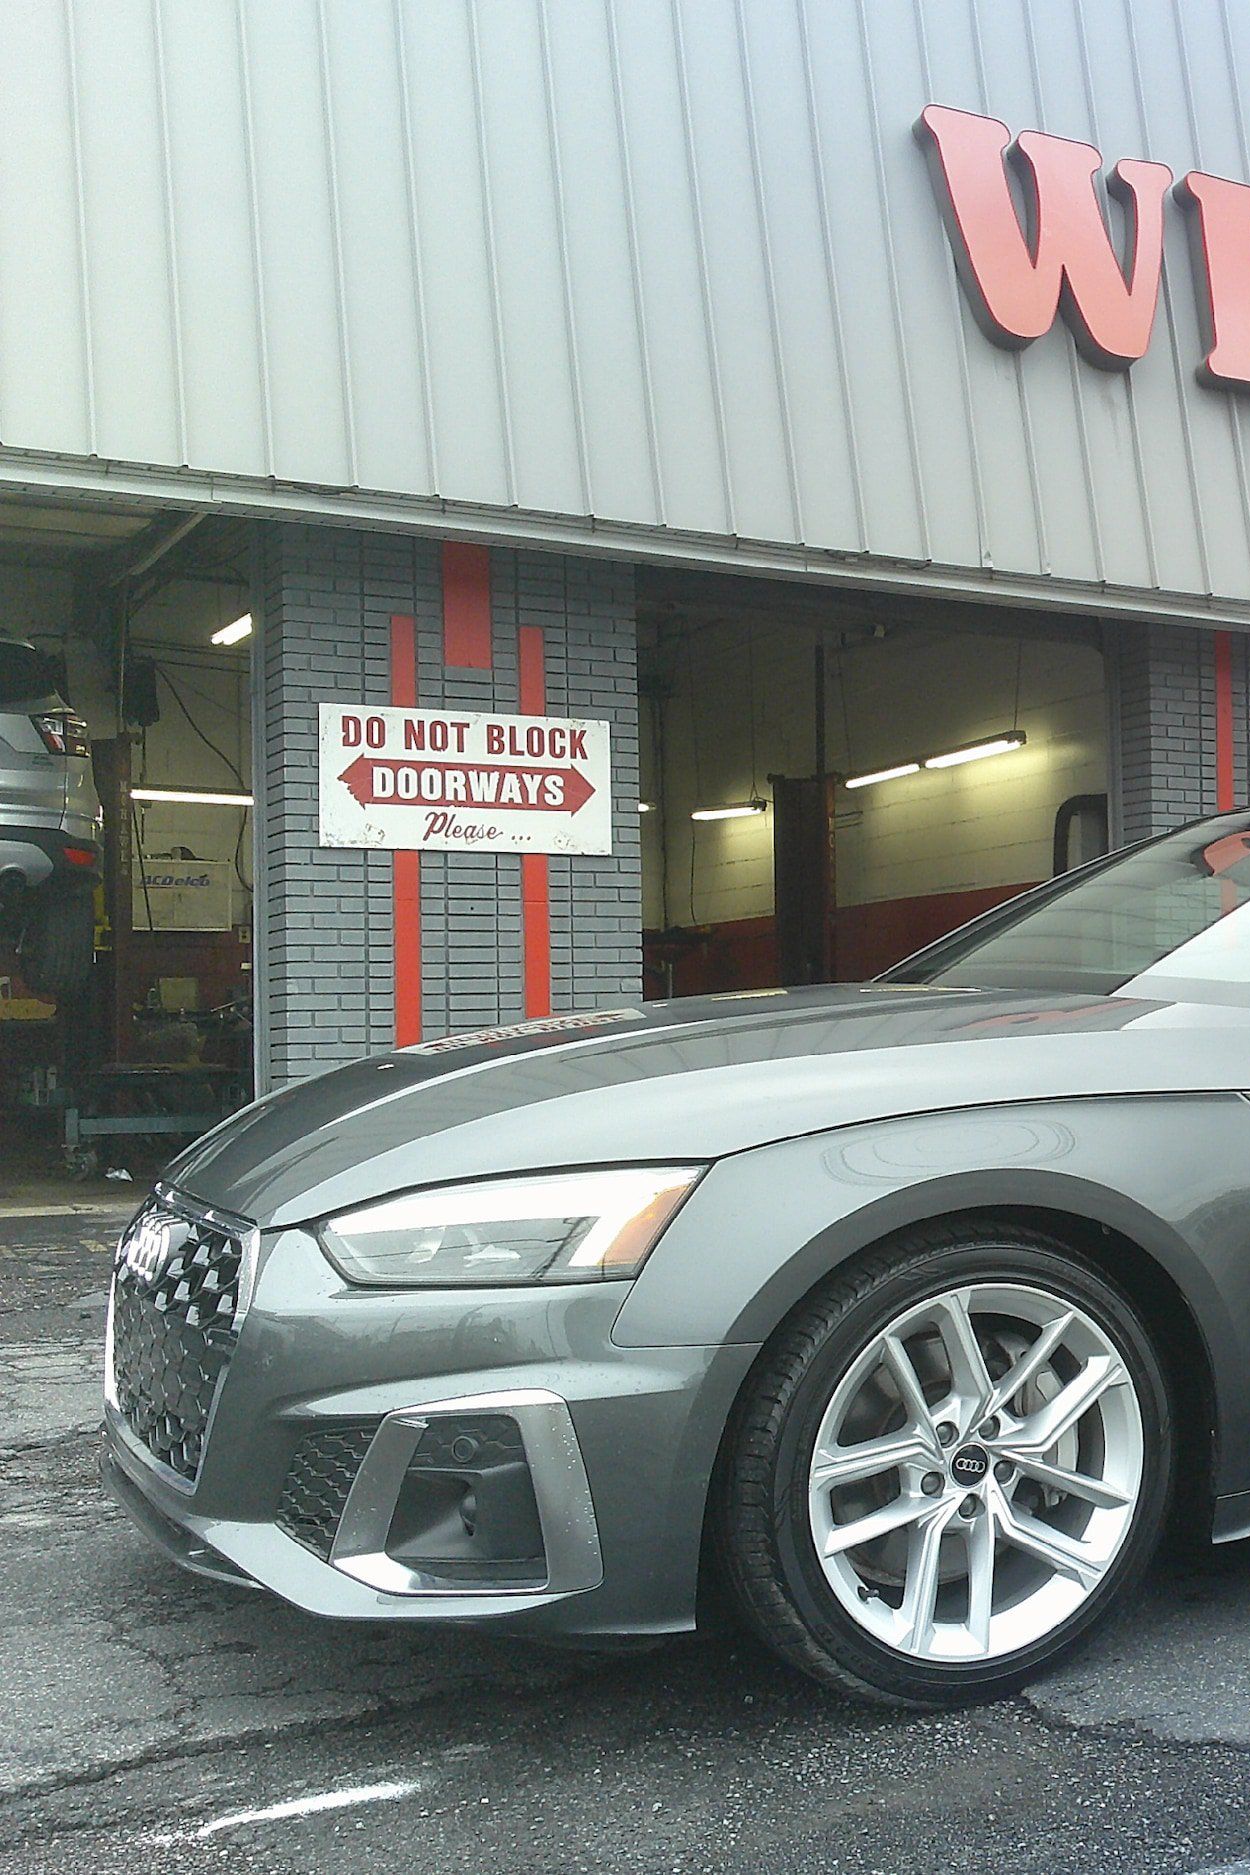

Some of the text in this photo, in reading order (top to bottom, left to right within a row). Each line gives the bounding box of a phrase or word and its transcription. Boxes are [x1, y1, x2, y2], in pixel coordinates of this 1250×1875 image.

[341, 714, 588, 761] DO NOT BLOCK
[372, 765, 566, 807] DOORWAYS
[422, 811, 504, 842] Please
[139, 873, 211, 888] ACDelco
